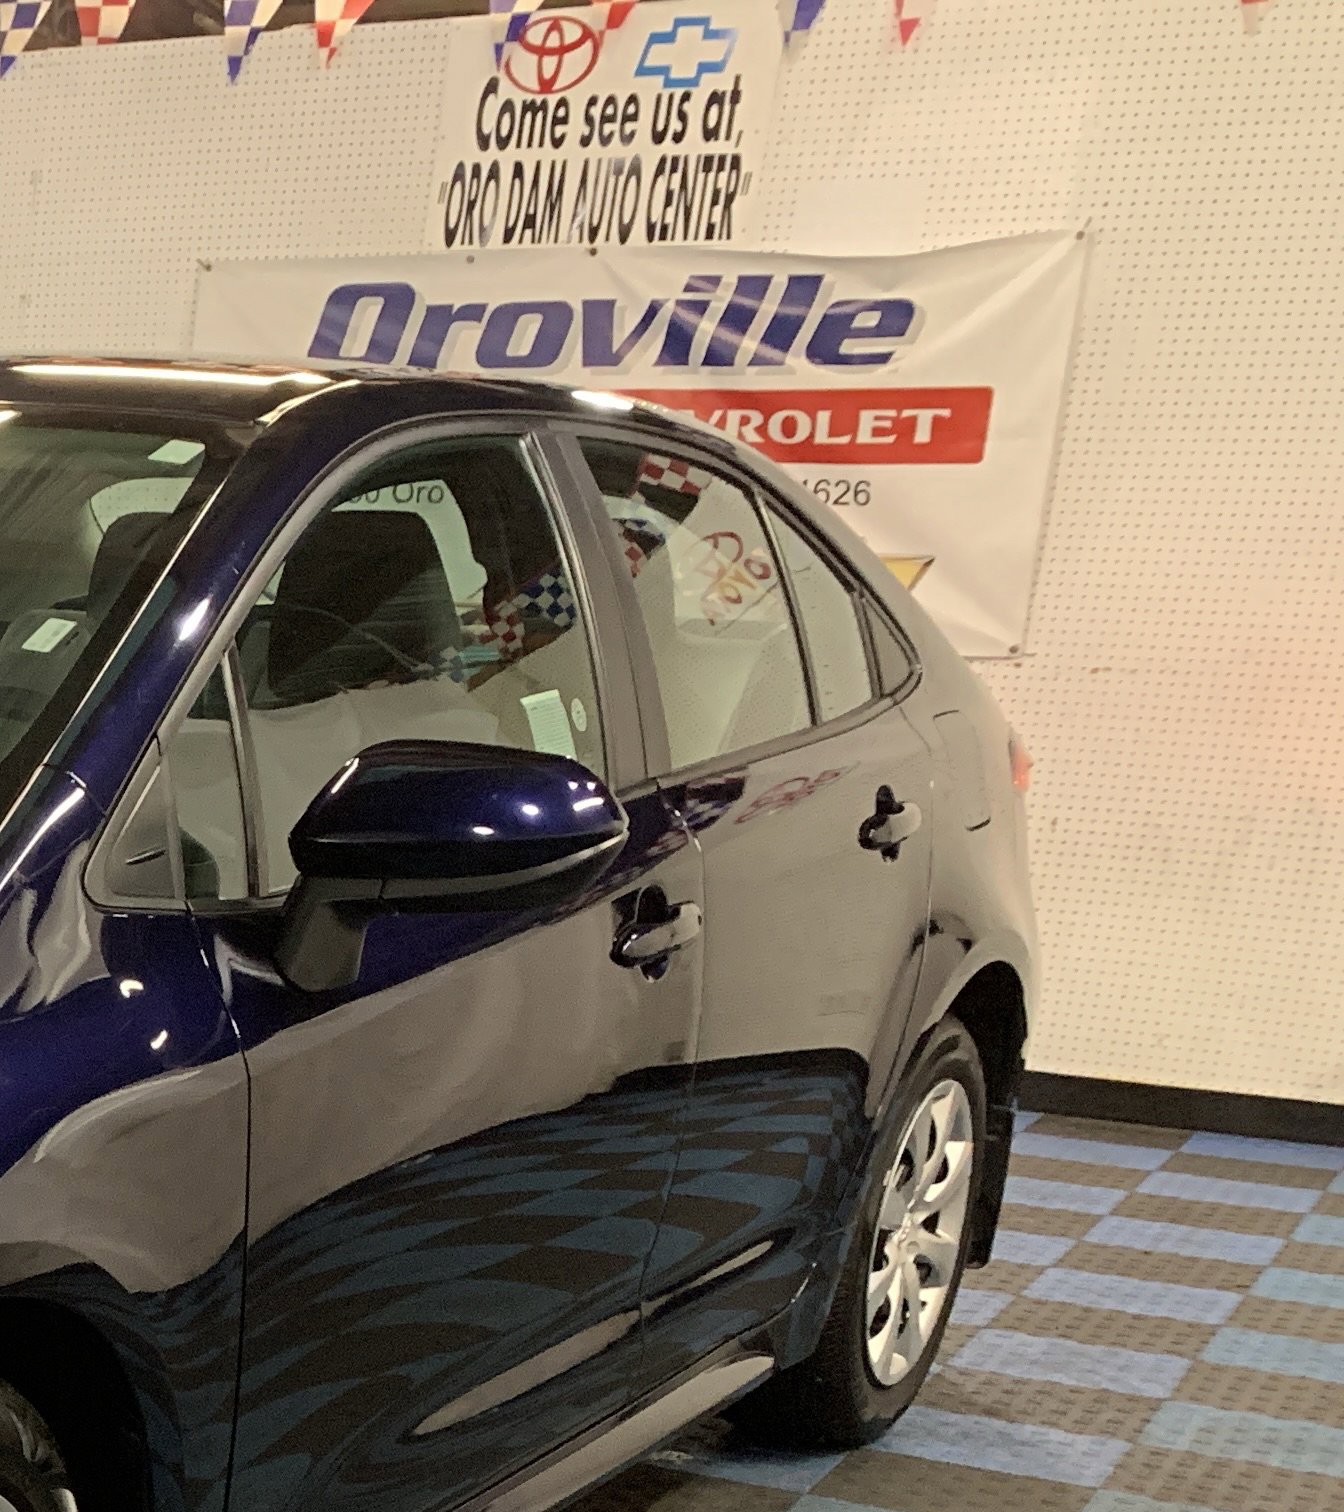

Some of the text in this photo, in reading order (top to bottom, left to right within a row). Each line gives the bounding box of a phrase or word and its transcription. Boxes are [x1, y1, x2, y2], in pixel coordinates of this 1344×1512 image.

[475, 73, 744, 151] Come see us at,
[502, 159, 568, 245] DAM
[566, 154, 643, 245] AUTO
[646, 153, 753, 243] CENTER"
[308, 274, 916, 369] Oroville
[694, 408, 952, 445] ROLET
